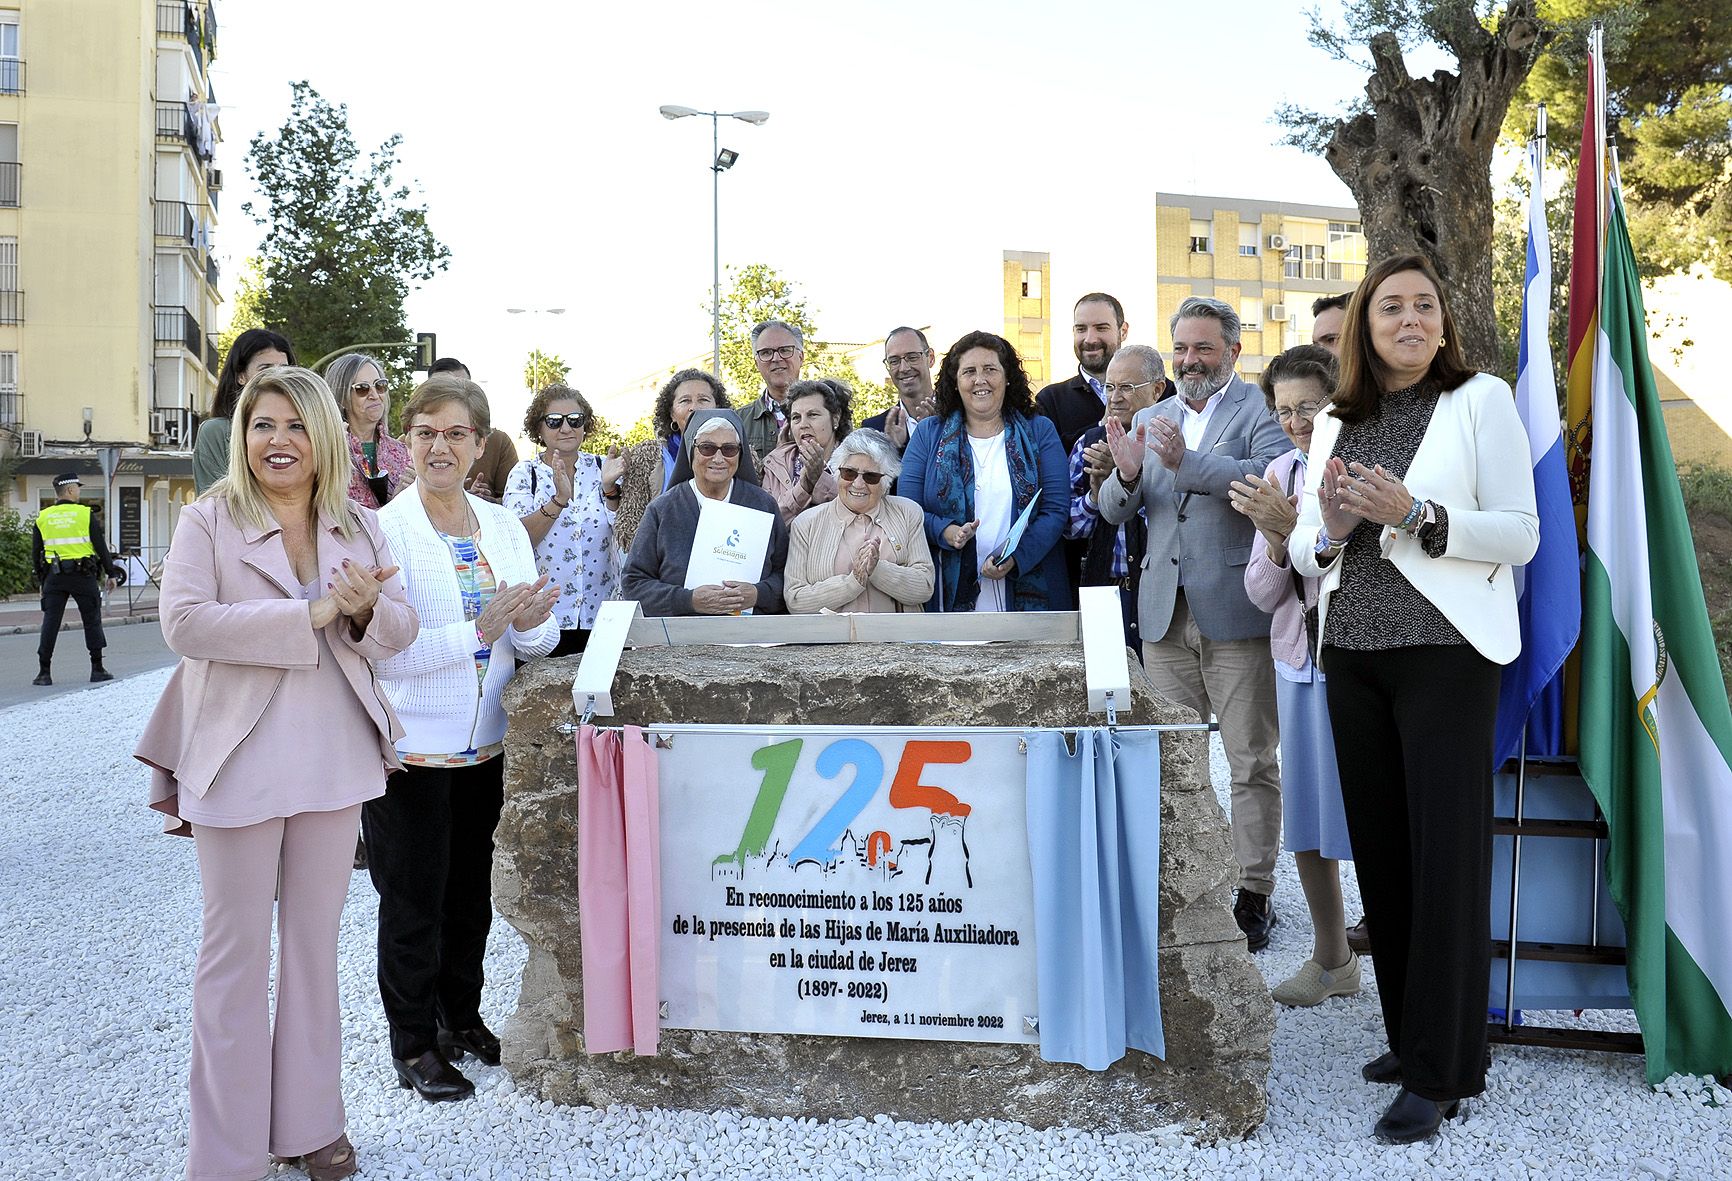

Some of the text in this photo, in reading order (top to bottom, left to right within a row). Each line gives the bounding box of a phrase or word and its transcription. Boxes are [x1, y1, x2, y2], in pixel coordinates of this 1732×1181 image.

[712, 738, 972, 866] 125
[726, 886, 963, 913] En reconocimiento a los 125 años
[673, 914, 1020, 946] de la presencia de las Hijas de María Auxiliadora
[769, 948, 917, 973] en la ciudad de Jerez
[797, 978, 888, 1003] (1897- 2022)
[860, 1010, 1004, 1029] Jerez, a 11 noviembre 2022
